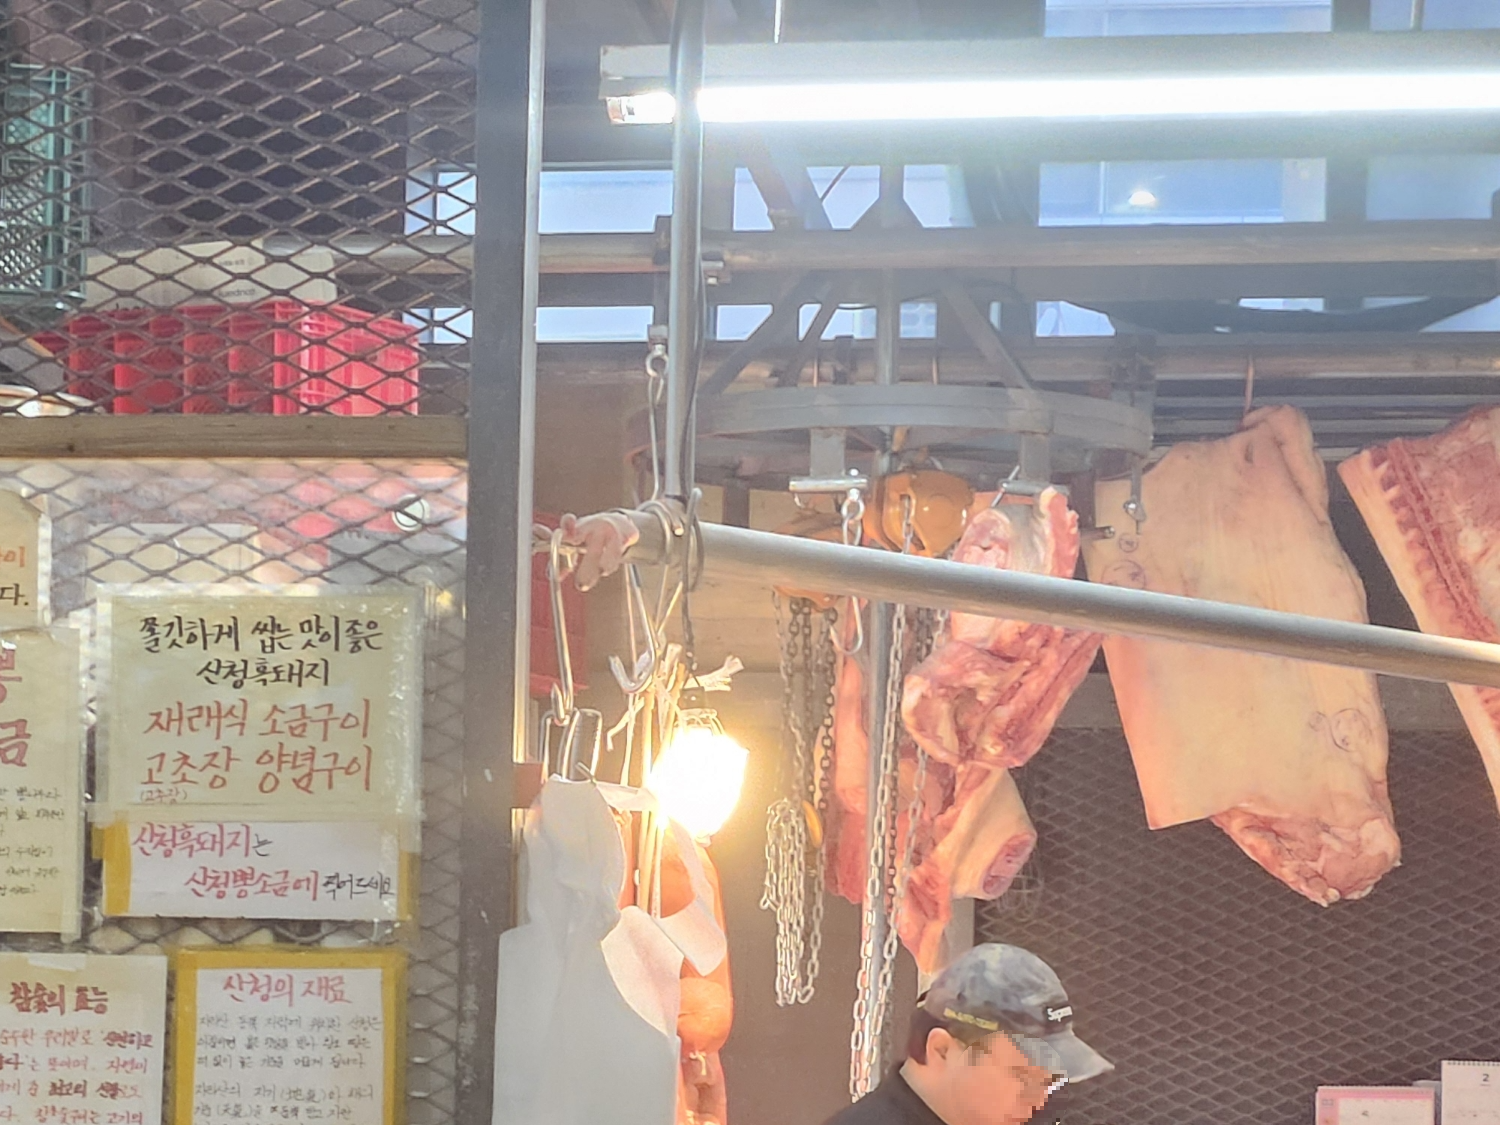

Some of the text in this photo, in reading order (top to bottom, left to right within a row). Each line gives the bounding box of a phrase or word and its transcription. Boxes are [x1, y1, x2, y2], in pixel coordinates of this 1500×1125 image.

[139, 615, 240, 653] 쫄깃하게
[251, 615, 294, 654] 씹는
[196, 658, 330, 689] 산청흑돼지
[143, 698, 371, 742] 재래식 소금구이
[141, 742, 372, 794] 고초장 양념구이
[132, 821, 273, 858] 산청흑돼지는
[222, 972, 353, 1008] 산청의 재료
